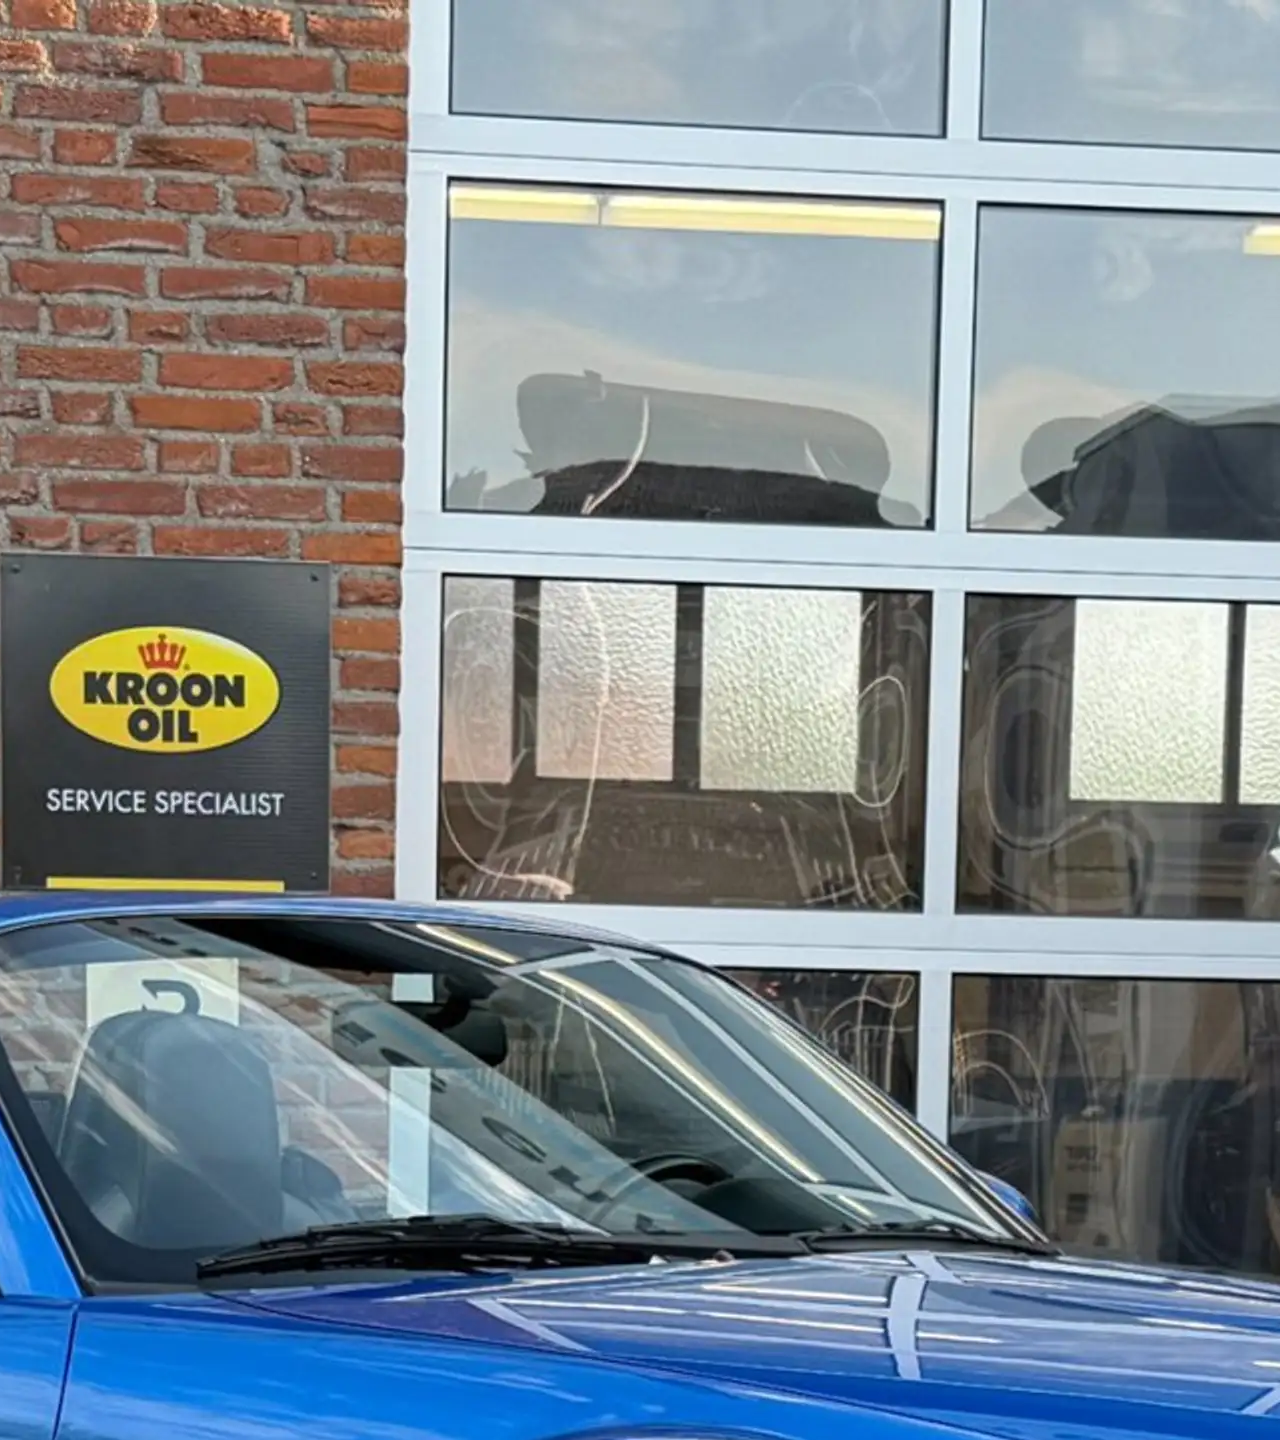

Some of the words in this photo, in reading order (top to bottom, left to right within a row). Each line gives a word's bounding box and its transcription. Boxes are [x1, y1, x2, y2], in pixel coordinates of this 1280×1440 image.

[82, 671, 246, 708] KROON
[127, 708, 199, 743] OIL
[46, 788, 146, 814] SERVICE
[154, 791, 285, 817] SPECIALIST
